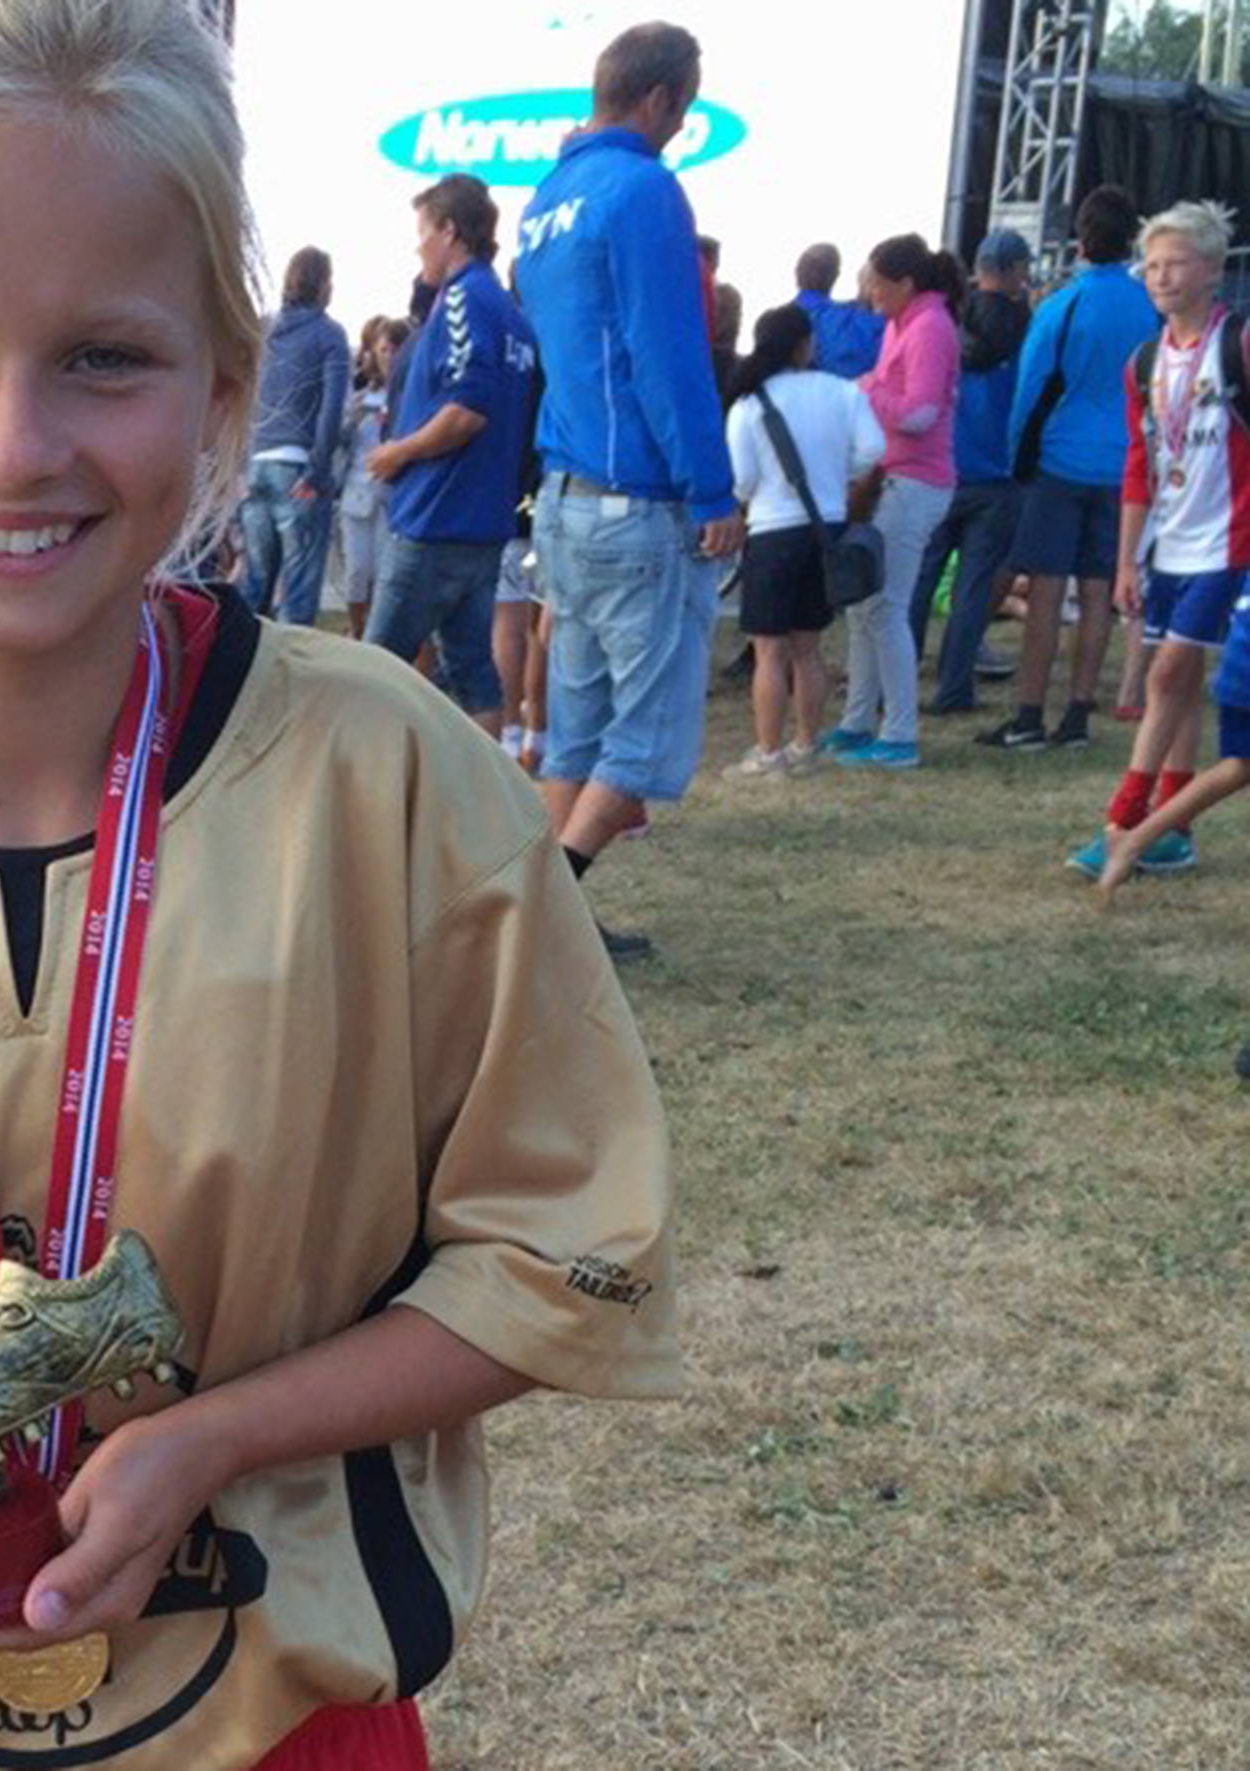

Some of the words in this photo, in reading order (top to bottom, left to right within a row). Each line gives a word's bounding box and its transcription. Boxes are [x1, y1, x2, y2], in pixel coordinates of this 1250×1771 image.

[108, 752, 131, 797] 2014
[134, 856, 154, 901] 2014
[84, 910, 108, 956] 2014
[111, 1015, 134, 1061] 2014
[62, 1068, 82, 1113] 2014
[93, 1176, 114, 1221] 2014
[46, 1228, 64, 1272] 2014
